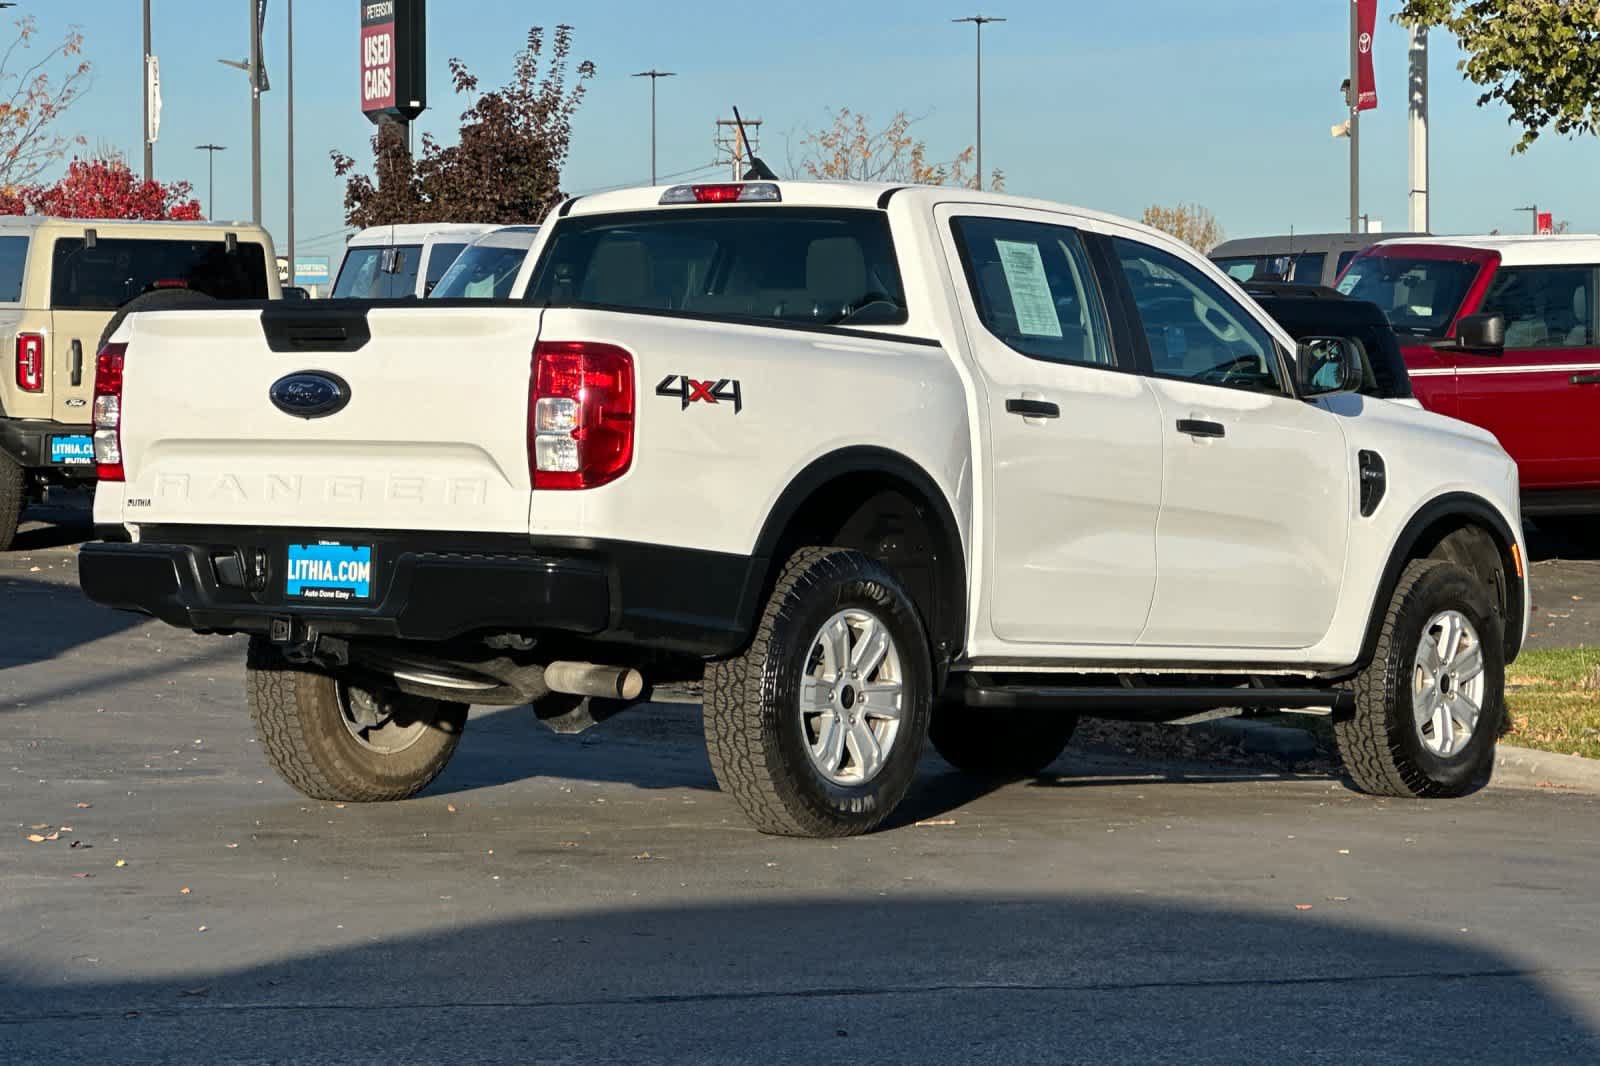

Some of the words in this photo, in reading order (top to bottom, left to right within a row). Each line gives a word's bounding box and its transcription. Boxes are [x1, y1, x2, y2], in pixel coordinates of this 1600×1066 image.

[367, 2, 393, 19] PETERSON
[364, 33, 391, 68] USED
[364, 67, 391, 101] CARS
[52, 443, 94, 454] LITHIA.C
[155, 472, 488, 505] RANGER
[287, 560, 371, 582] LITHIA.COM
[304, 589, 318, 598] Auto
[319, 590, 334, 598] Done
[335, 590, 350, 600] Easy
